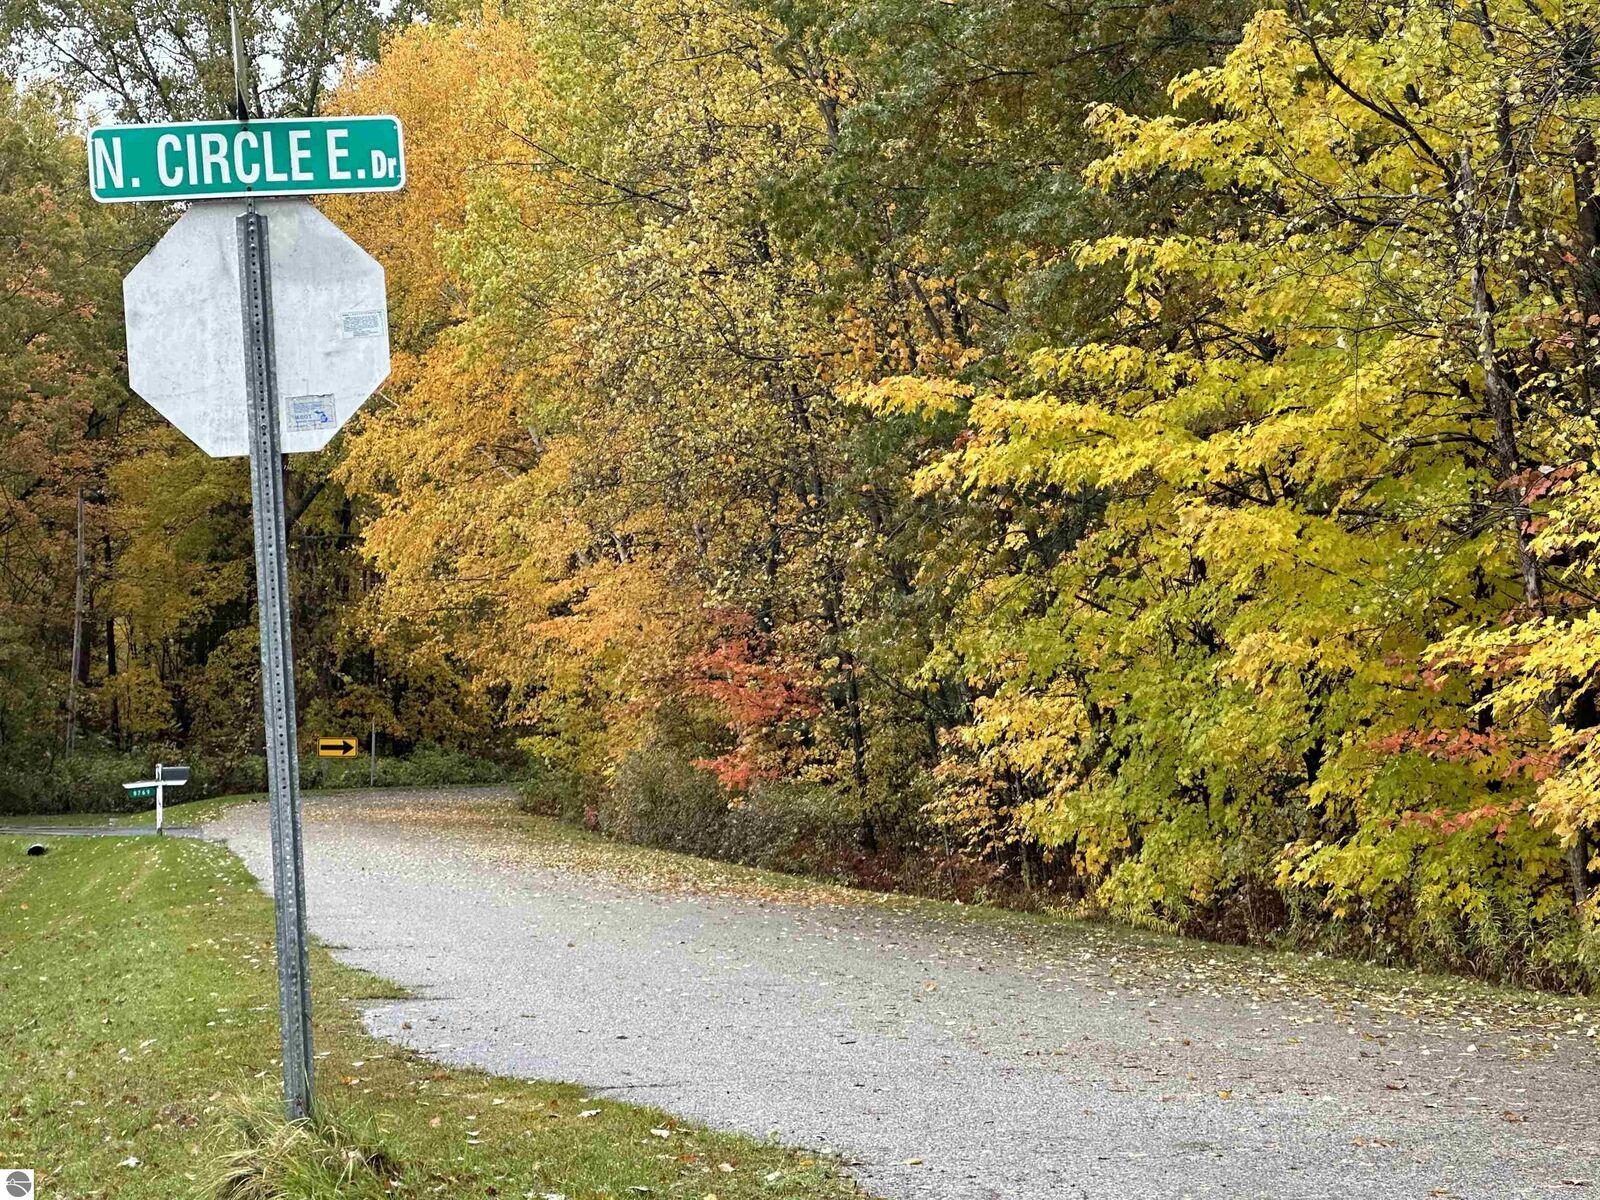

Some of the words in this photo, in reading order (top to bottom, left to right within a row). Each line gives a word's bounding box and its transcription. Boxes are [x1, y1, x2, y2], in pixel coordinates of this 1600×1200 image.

[94, 137, 140, 189] N.
[157, 130, 314, 187] CIRCLE
[371, 150, 397, 179] Dr
